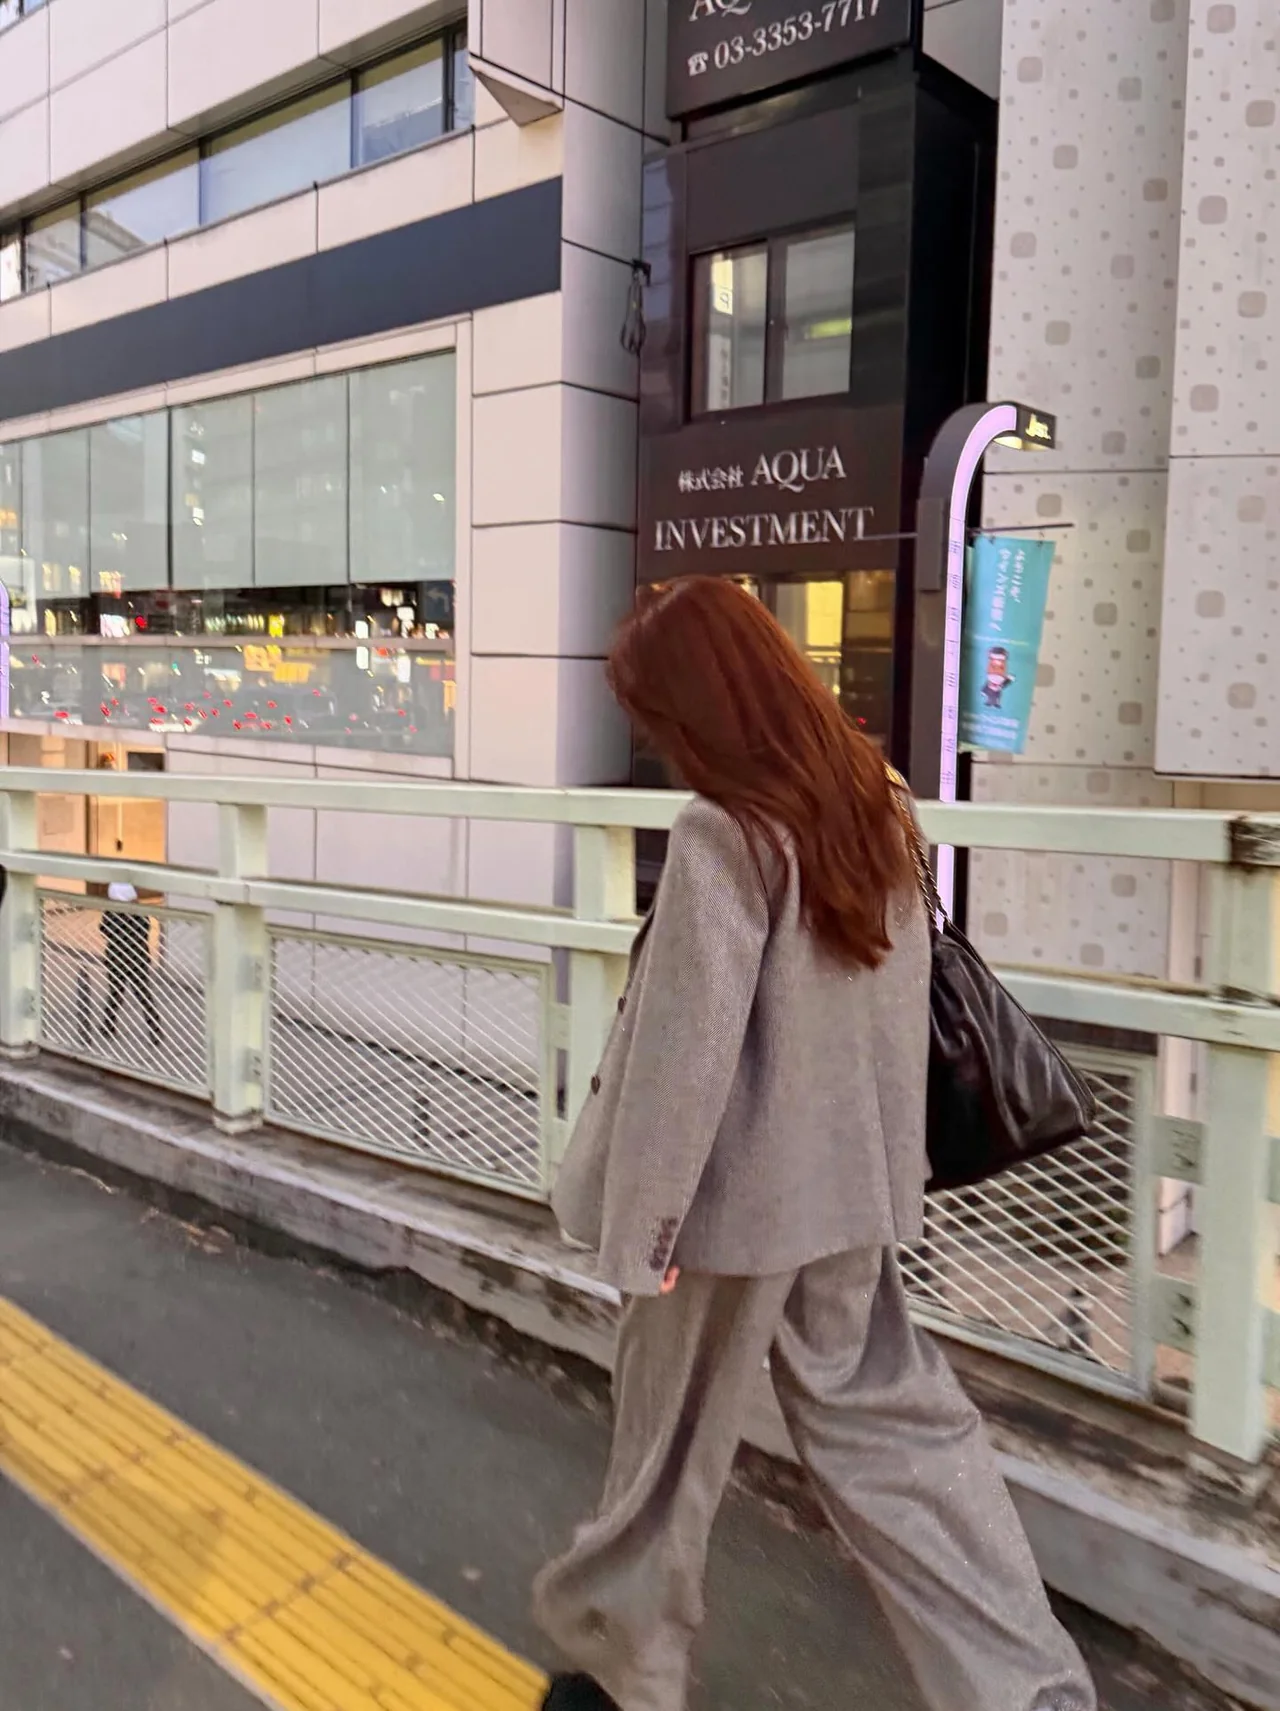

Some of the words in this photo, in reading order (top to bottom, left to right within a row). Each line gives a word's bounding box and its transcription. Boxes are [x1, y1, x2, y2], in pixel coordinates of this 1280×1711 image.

[678, 463, 744, 493] 株式会社
[750, 445, 847, 493] AQUA
[654, 506, 875, 551] INVESTMENT
